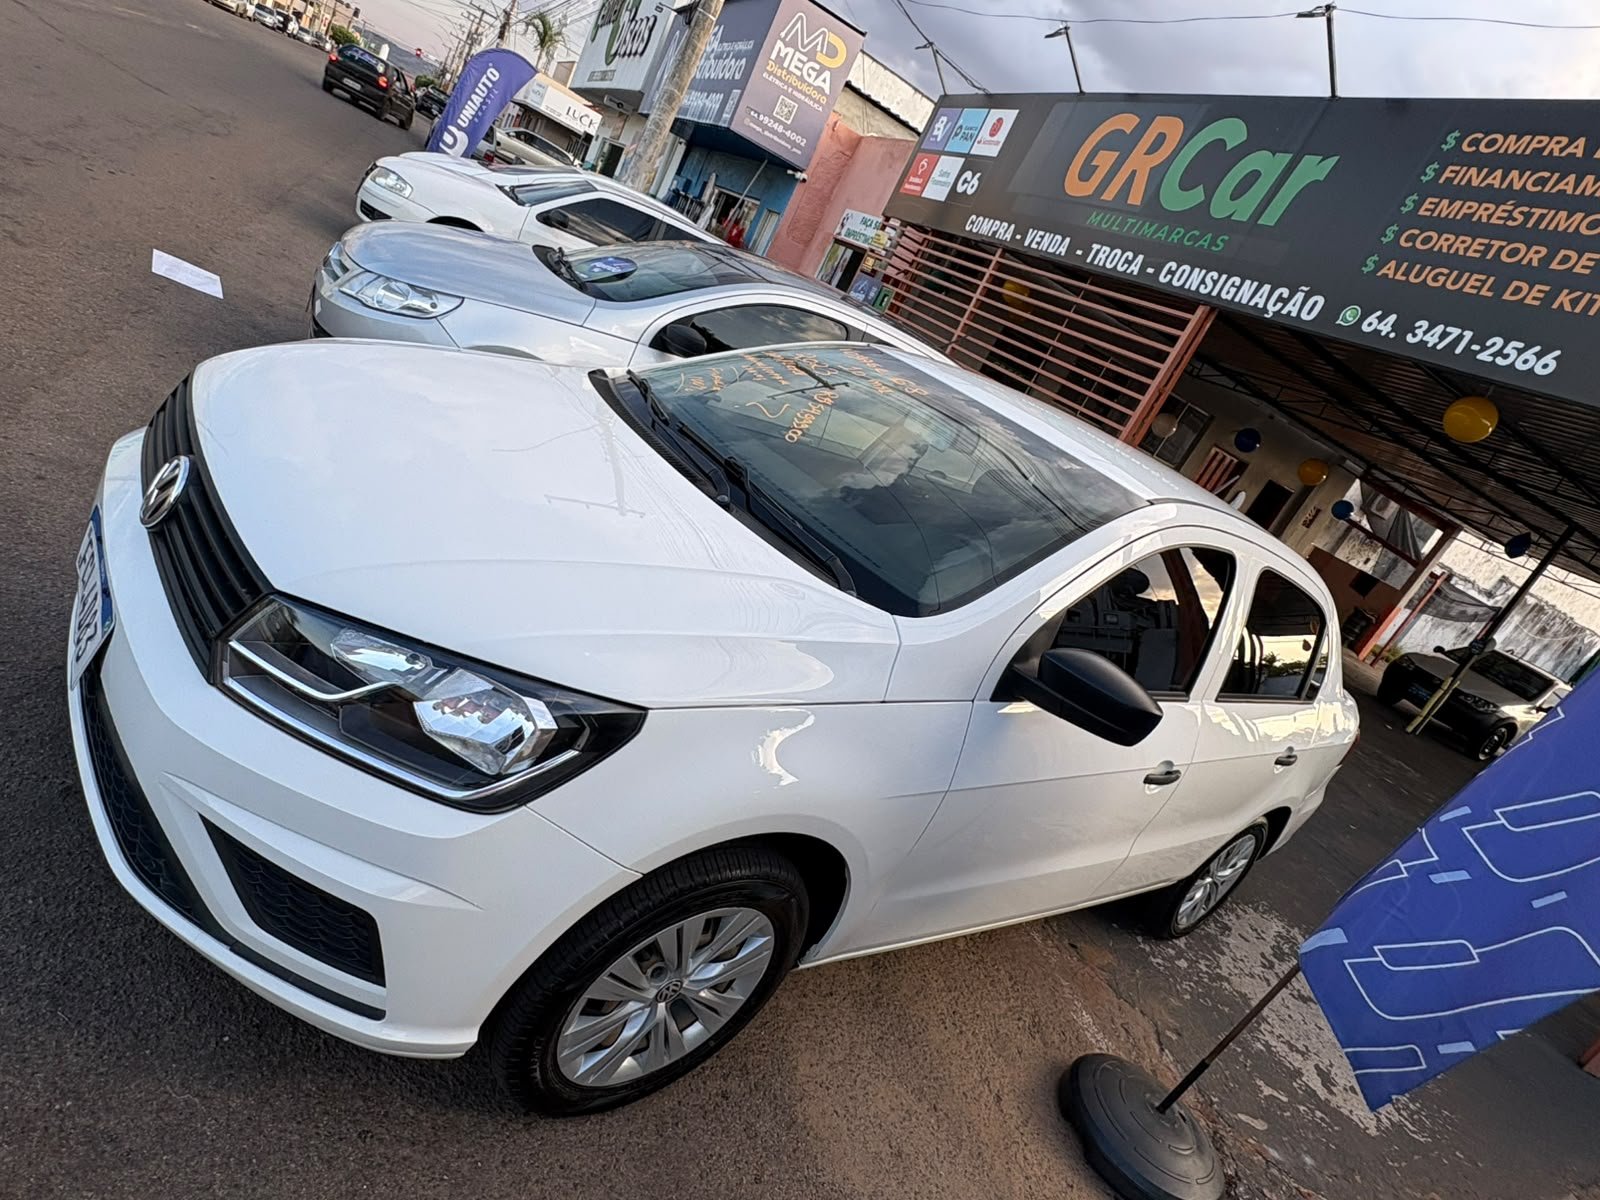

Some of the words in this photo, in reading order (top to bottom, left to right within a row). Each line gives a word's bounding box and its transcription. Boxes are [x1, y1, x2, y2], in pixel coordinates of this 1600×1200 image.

[766, 61, 827, 105] Distribuidora
[769, 39, 831, 95] MEGA
[457, 67, 500, 128] UNIAUTO
[758, 113, 808, 148] 99248-4002
[960, 131, 975, 142] PAN
[1461, 132, 1586, 159] COMPRA
[956, 170, 982, 195] C6
[1063, 113, 1341, 227] GRCar
[1086, 210, 1230, 252] MULTIMARCAS
[1399, 228, 1549, 268] CORRETOR
[1548, 249, 1599, 275] DE
[965, 213, 1016, 242] COMPRA
[1023, 228, 1072, 257] VENDA
[1086, 243, 1145, 276] TROCA
[1158, 261, 1326, 322] CONSIGNAÇÃO
[1376, 259, 1496, 298] ALUGUEL
[1501, 280, 1551, 308] DE
[1360, 309, 1397, 339] 64.
[1405, 319, 1562, 376] 3471-2566
